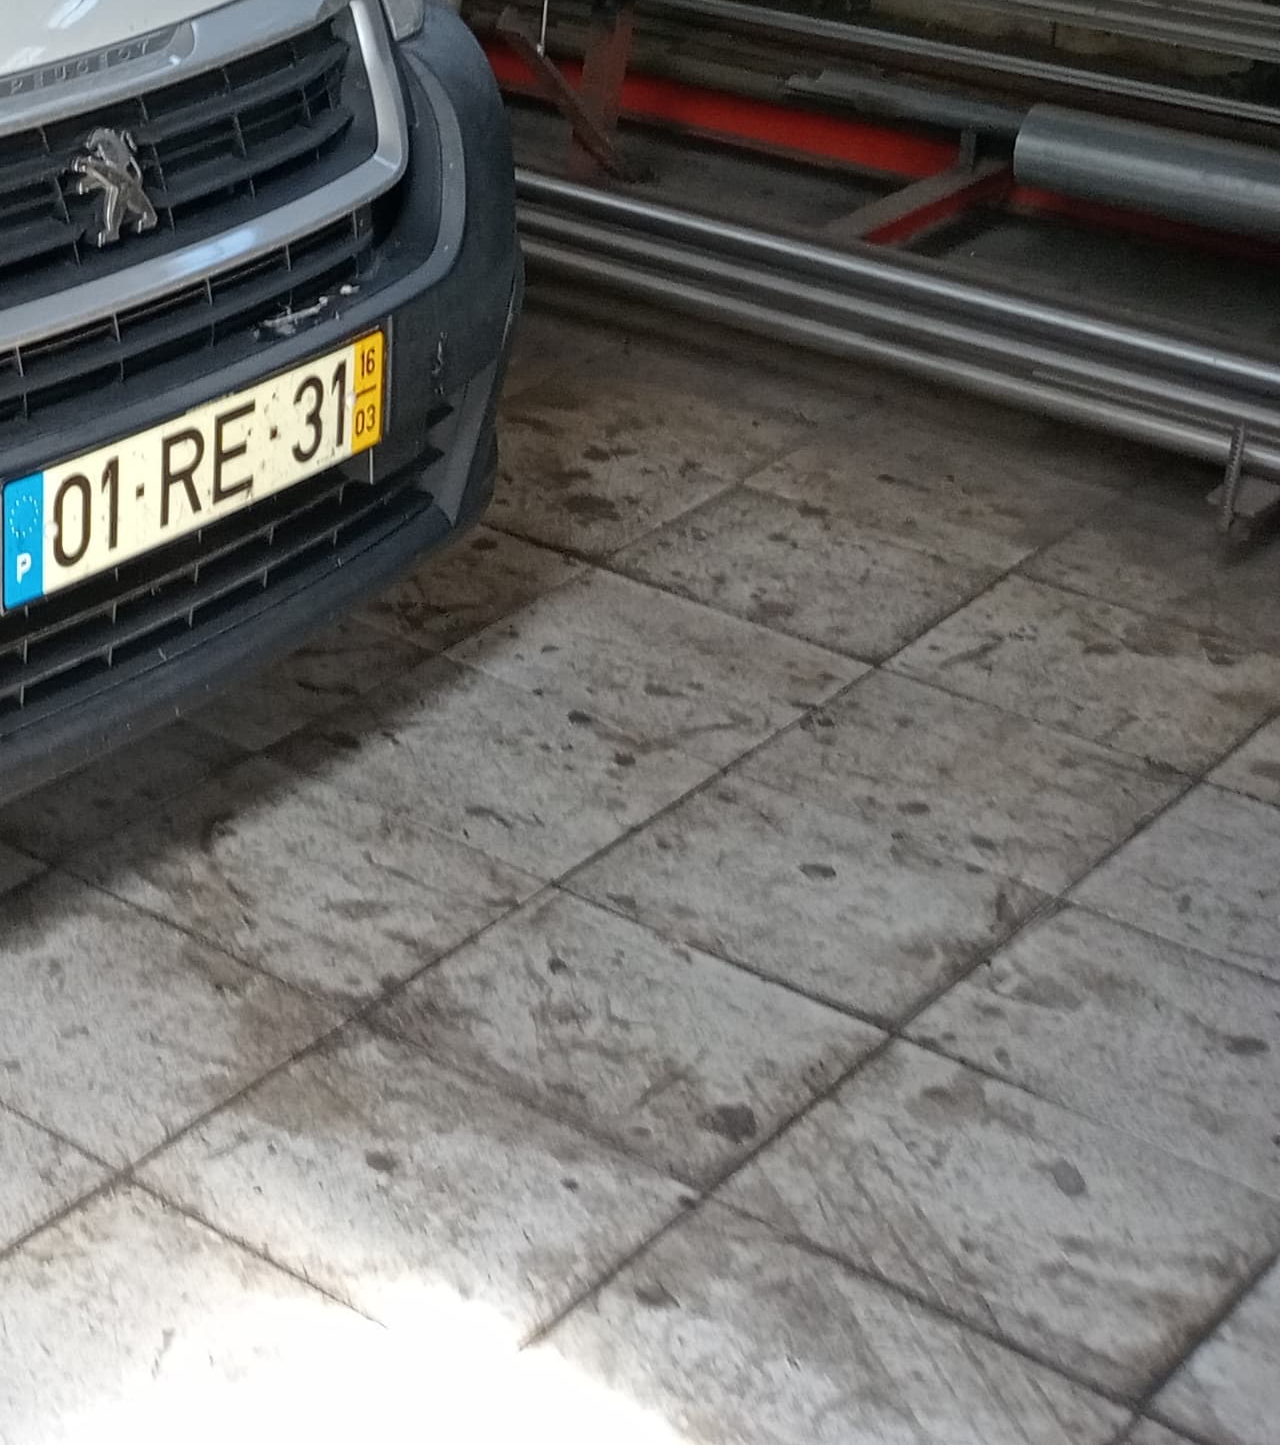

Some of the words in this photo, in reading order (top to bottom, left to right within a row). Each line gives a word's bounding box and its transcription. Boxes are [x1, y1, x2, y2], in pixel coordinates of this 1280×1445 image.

[359, 346, 377, 380] 16
[354, 404, 377, 438] 03
[16, 553, 32, 585] P
